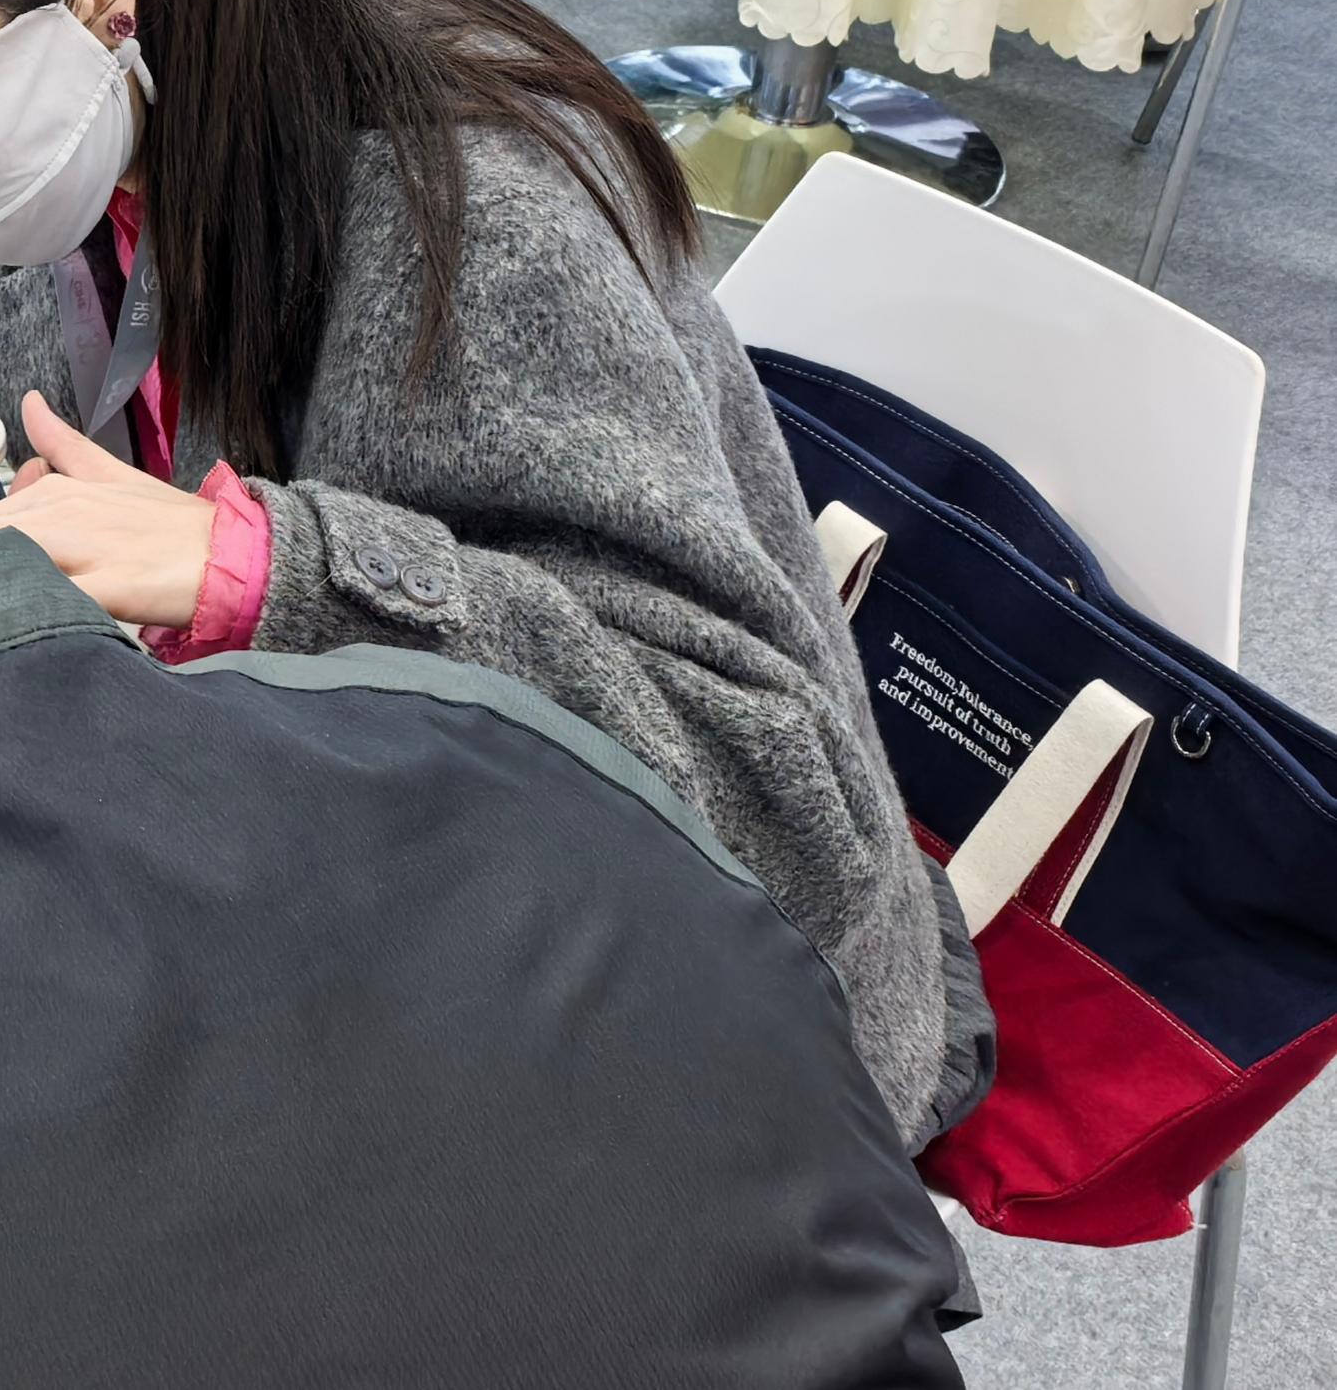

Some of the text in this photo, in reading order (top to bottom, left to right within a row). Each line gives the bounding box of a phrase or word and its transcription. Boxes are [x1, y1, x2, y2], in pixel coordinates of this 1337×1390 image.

[878, 677, 911, 707] and
[893, 665, 1012, 756] pursuit of truth
